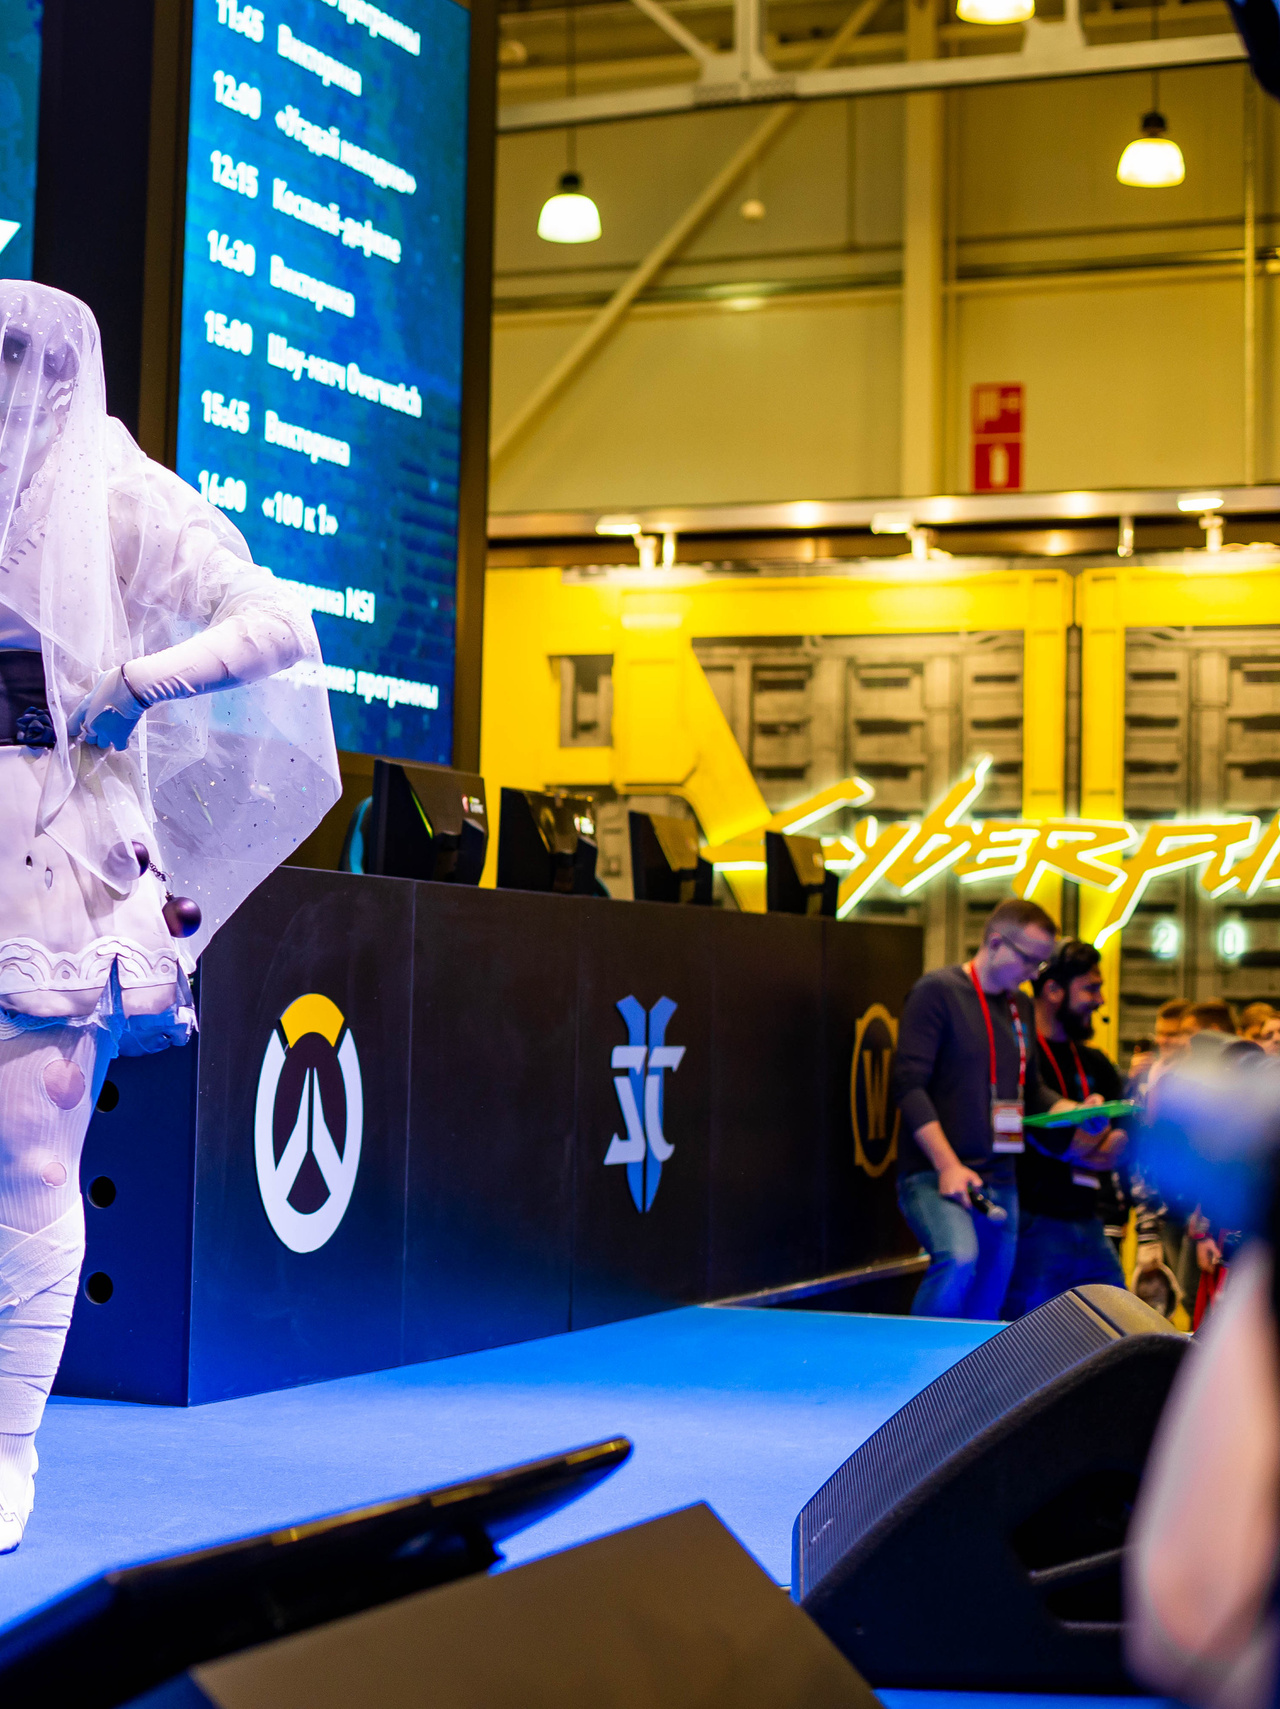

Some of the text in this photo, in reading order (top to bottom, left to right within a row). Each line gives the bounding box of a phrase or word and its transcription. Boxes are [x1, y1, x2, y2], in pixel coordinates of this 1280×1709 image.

[209, 150, 260, 199] 12:15
[206, 229, 257, 276] 14:30
[203, 310, 254, 356] 15:00
[200, 390, 351, 467] 15:45 Викторина
[346, 586, 376, 624] MSI
[356, 670, 440, 711] программы
